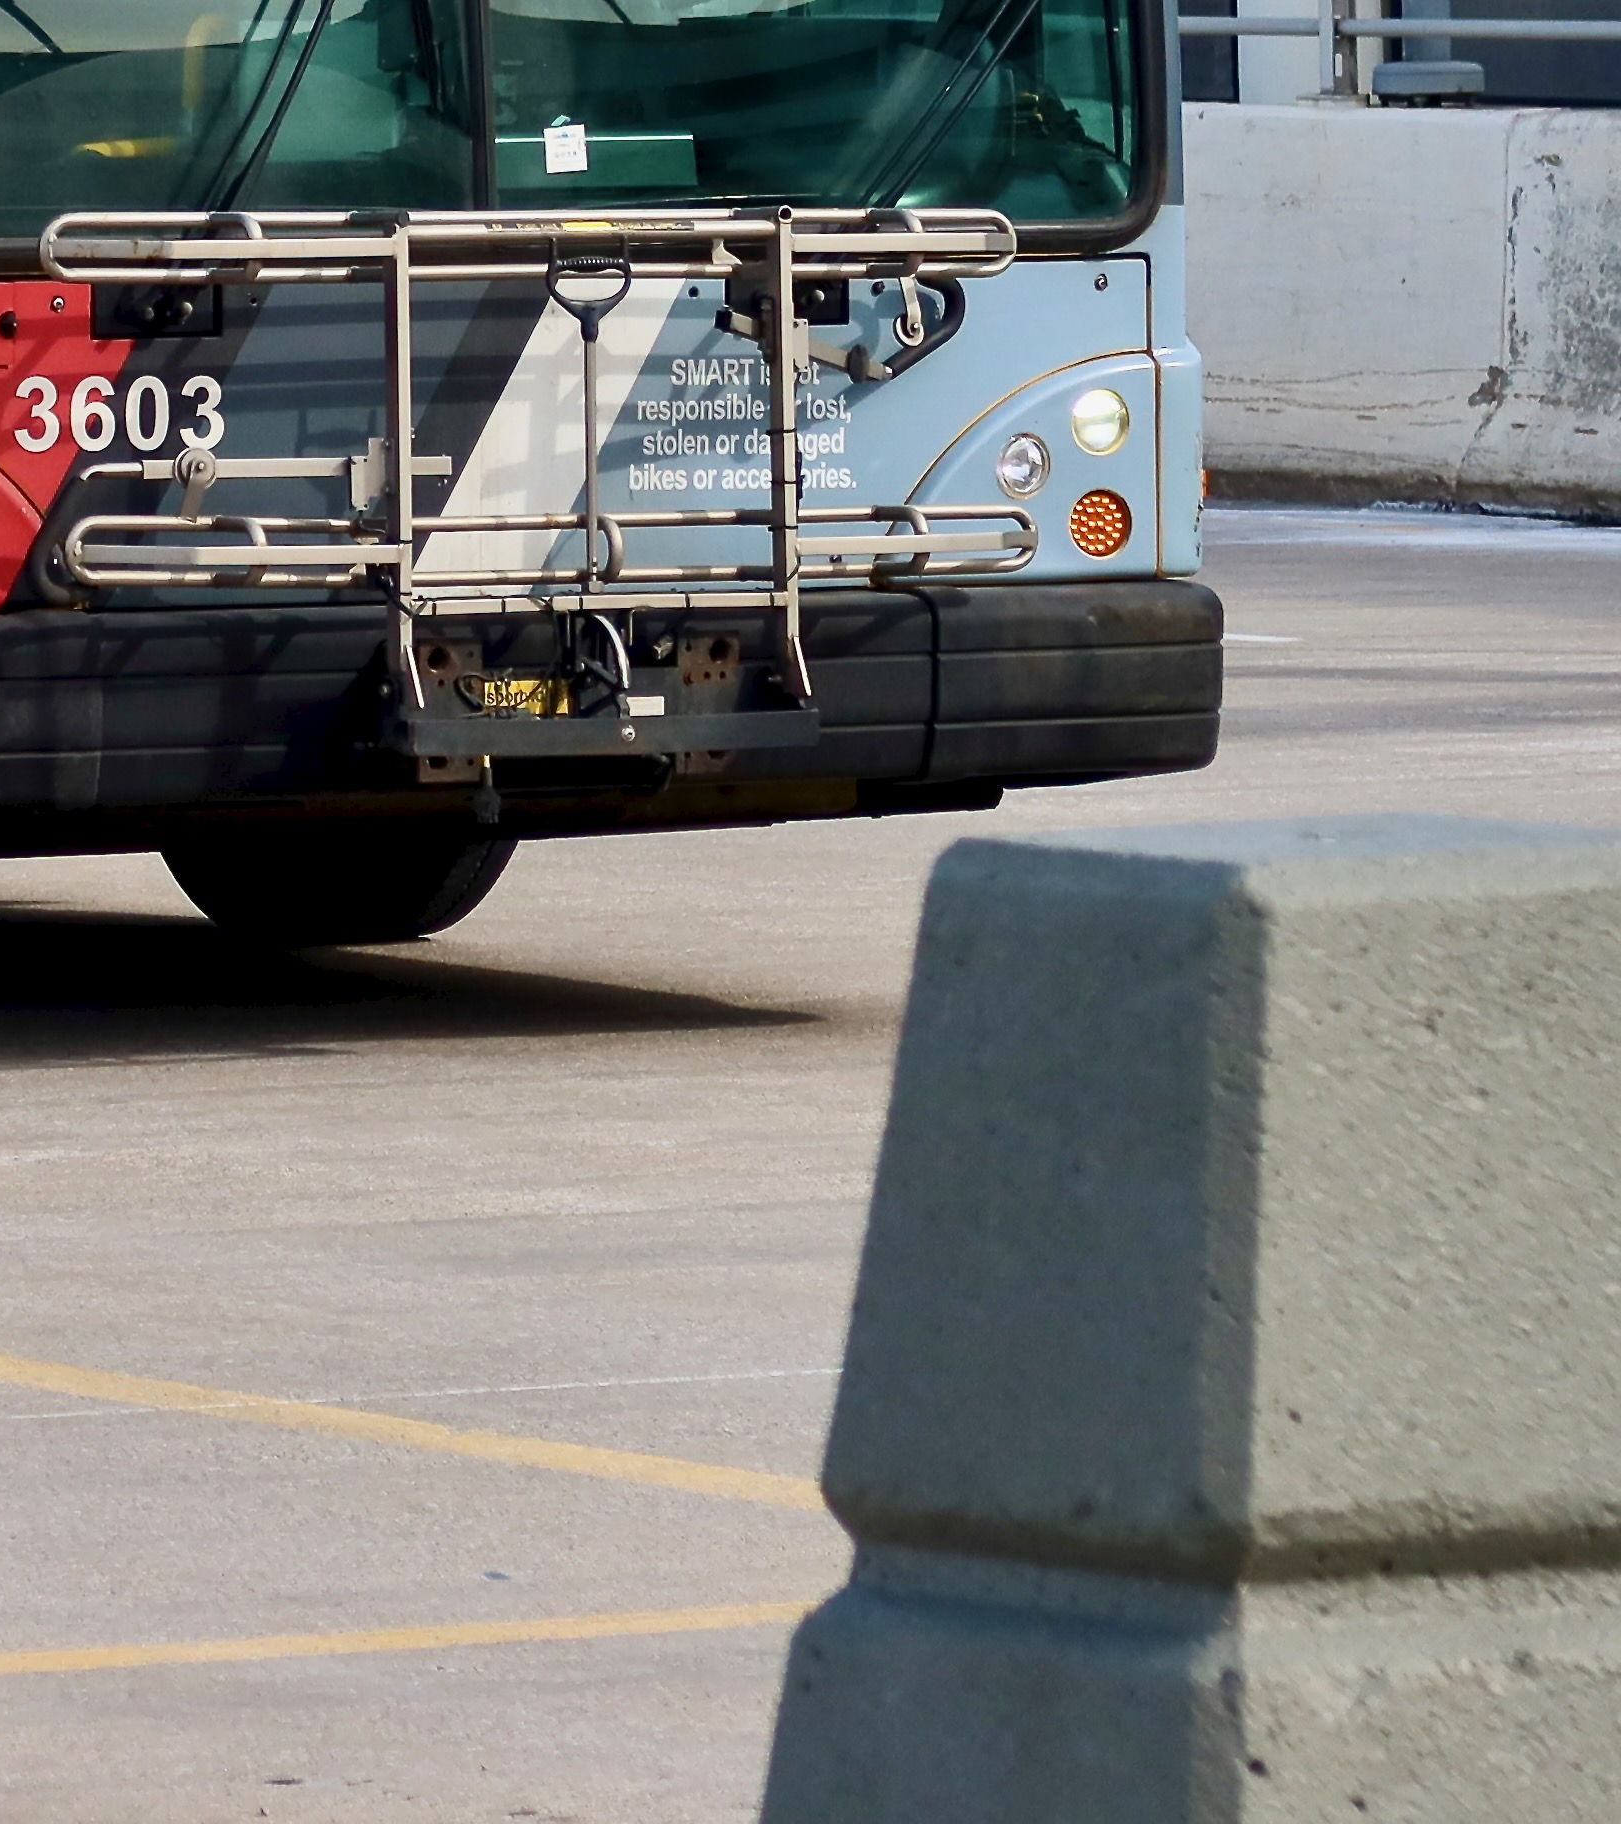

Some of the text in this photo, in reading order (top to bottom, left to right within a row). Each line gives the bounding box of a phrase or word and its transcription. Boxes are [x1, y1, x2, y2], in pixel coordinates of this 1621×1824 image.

[670, 358, 755, 386] SMART
[13, 374, 225, 453] 3603
[637, 392, 765, 427] responsible
[806, 392, 853, 424] lost,
[642, 426, 846, 462] stolen or daaged
[628, 461, 858, 491] bikes or acceories.
